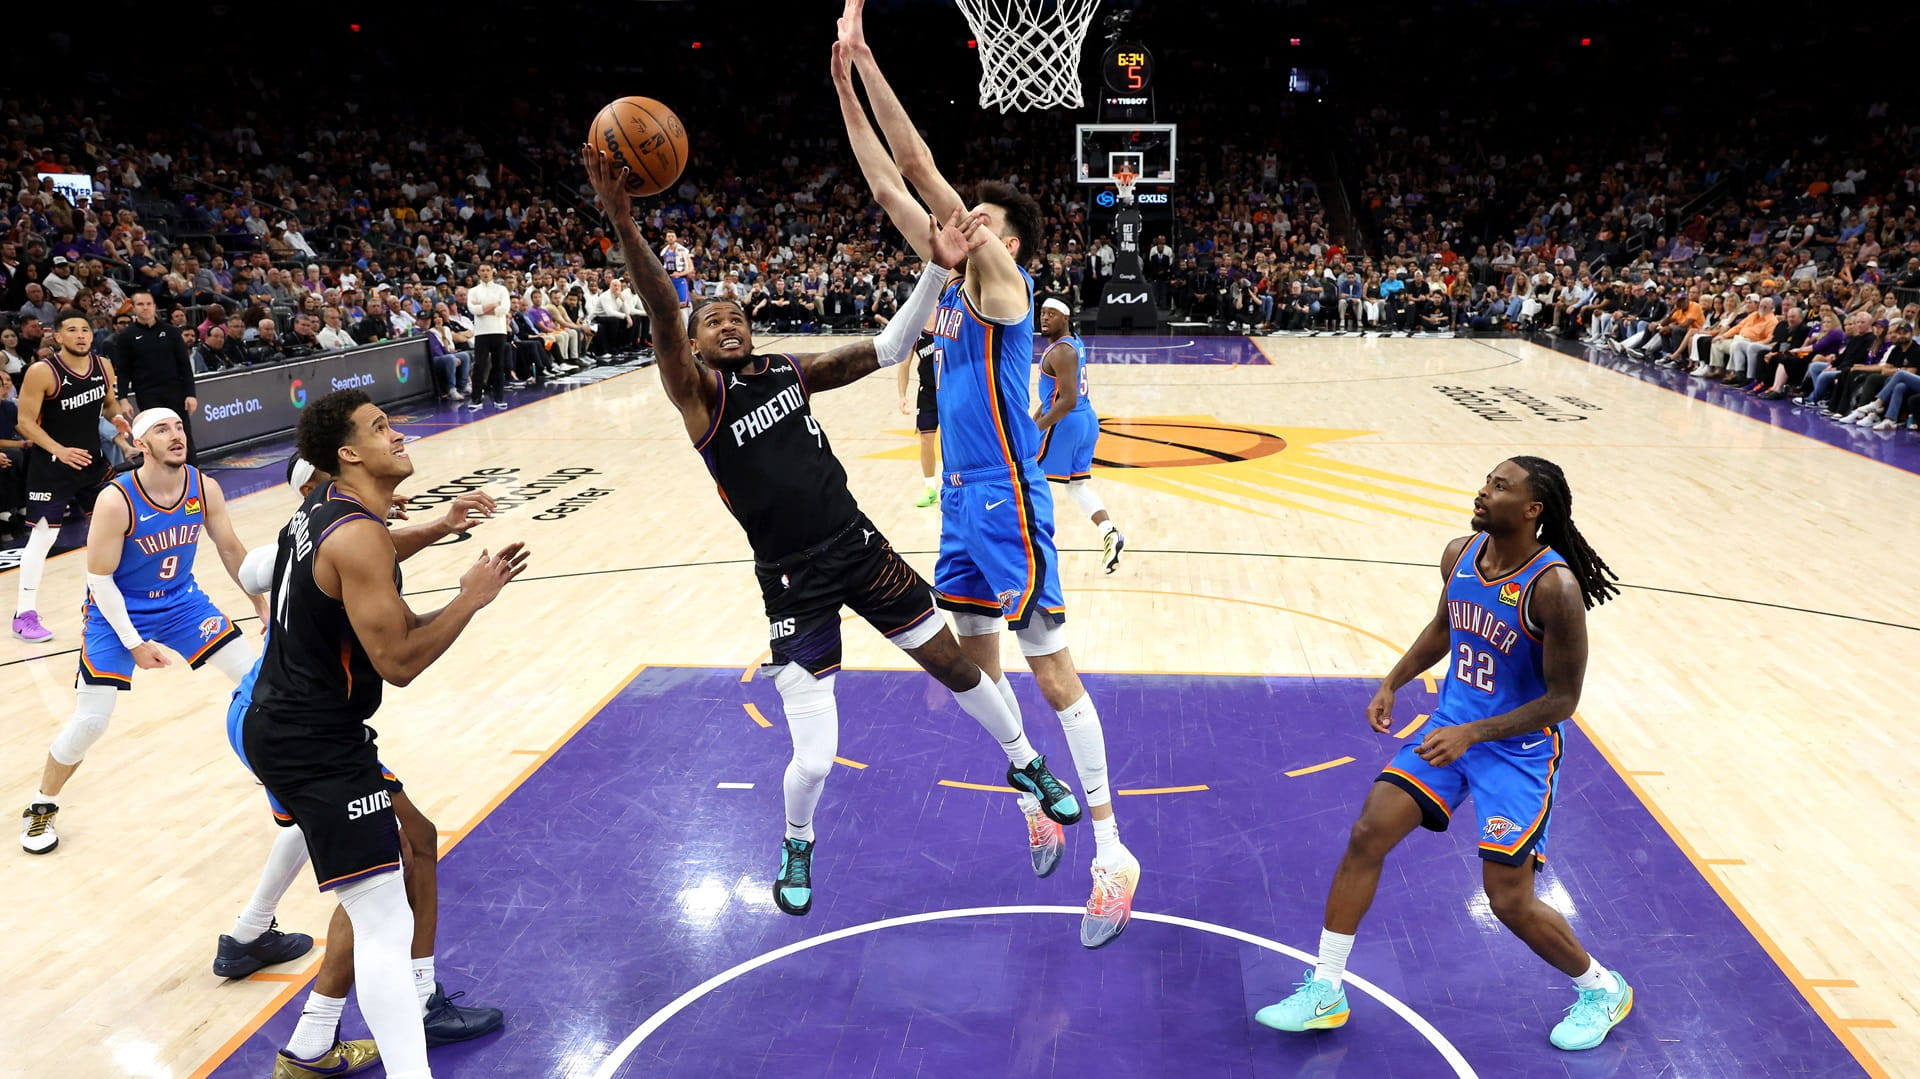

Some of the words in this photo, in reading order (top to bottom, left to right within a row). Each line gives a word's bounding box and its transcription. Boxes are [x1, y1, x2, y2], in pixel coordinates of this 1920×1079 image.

[1118, 53, 1144, 66] 6:34
[1128, 66, 1141, 88] 5
[1117, 97, 1148, 105] TISSOT
[1107, 292, 1148, 305] KIA
[331, 373, 360, 391] Search
[361, 372, 376, 387] on.
[60, 384, 107, 412] PHOENIX
[204, 399, 244, 423] Search
[245, 397, 263, 414] on.
[729, 382, 805, 448] PHOENIX
[532, 487, 615, 521] center
[158, 554, 179, 581] 9
[1447, 600, 1519, 656] THUNDER
[1456, 642, 1495, 694] 22
[347, 789, 392, 821] SUNS
